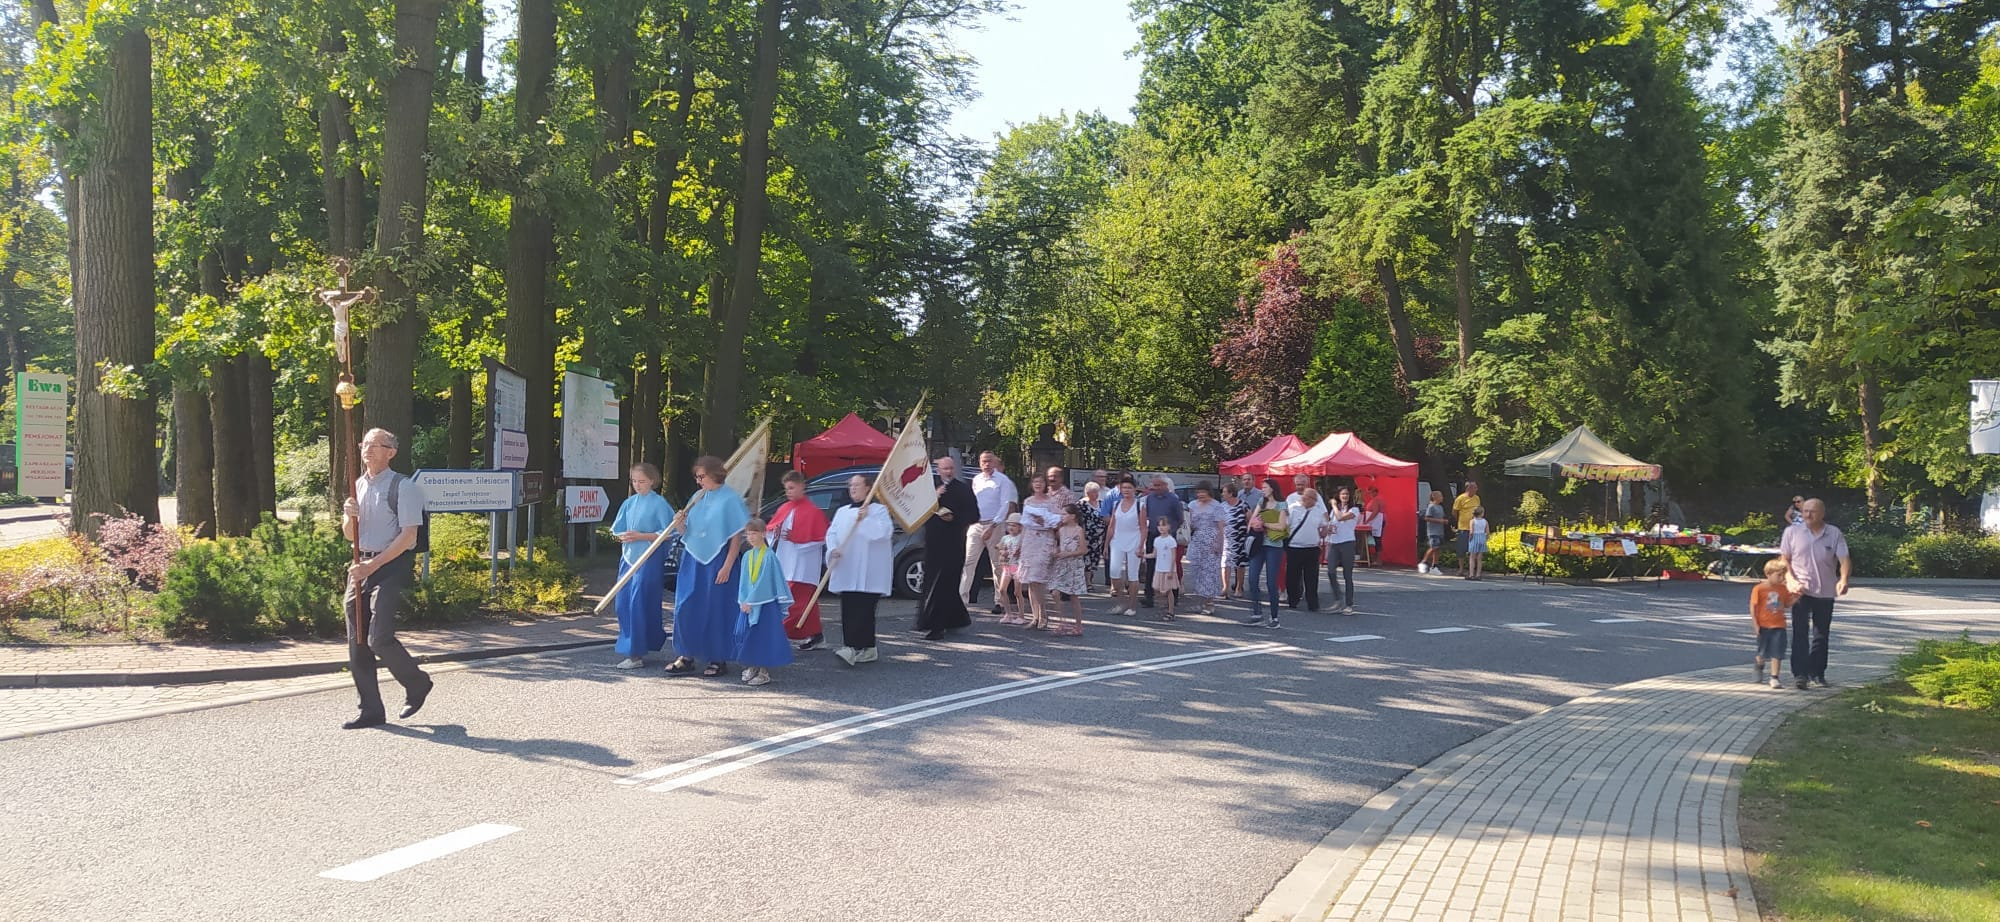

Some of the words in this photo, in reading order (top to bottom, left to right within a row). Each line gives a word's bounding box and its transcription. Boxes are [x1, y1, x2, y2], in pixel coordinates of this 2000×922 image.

[28, 379, 62, 392] Ewa
[423, 476, 473, 485] Sebastianeum
[475, 476, 510, 485] Silesiacum
[579, 490, 598, 503] PUNKT
[572, 505, 603, 518] APTECZNY
